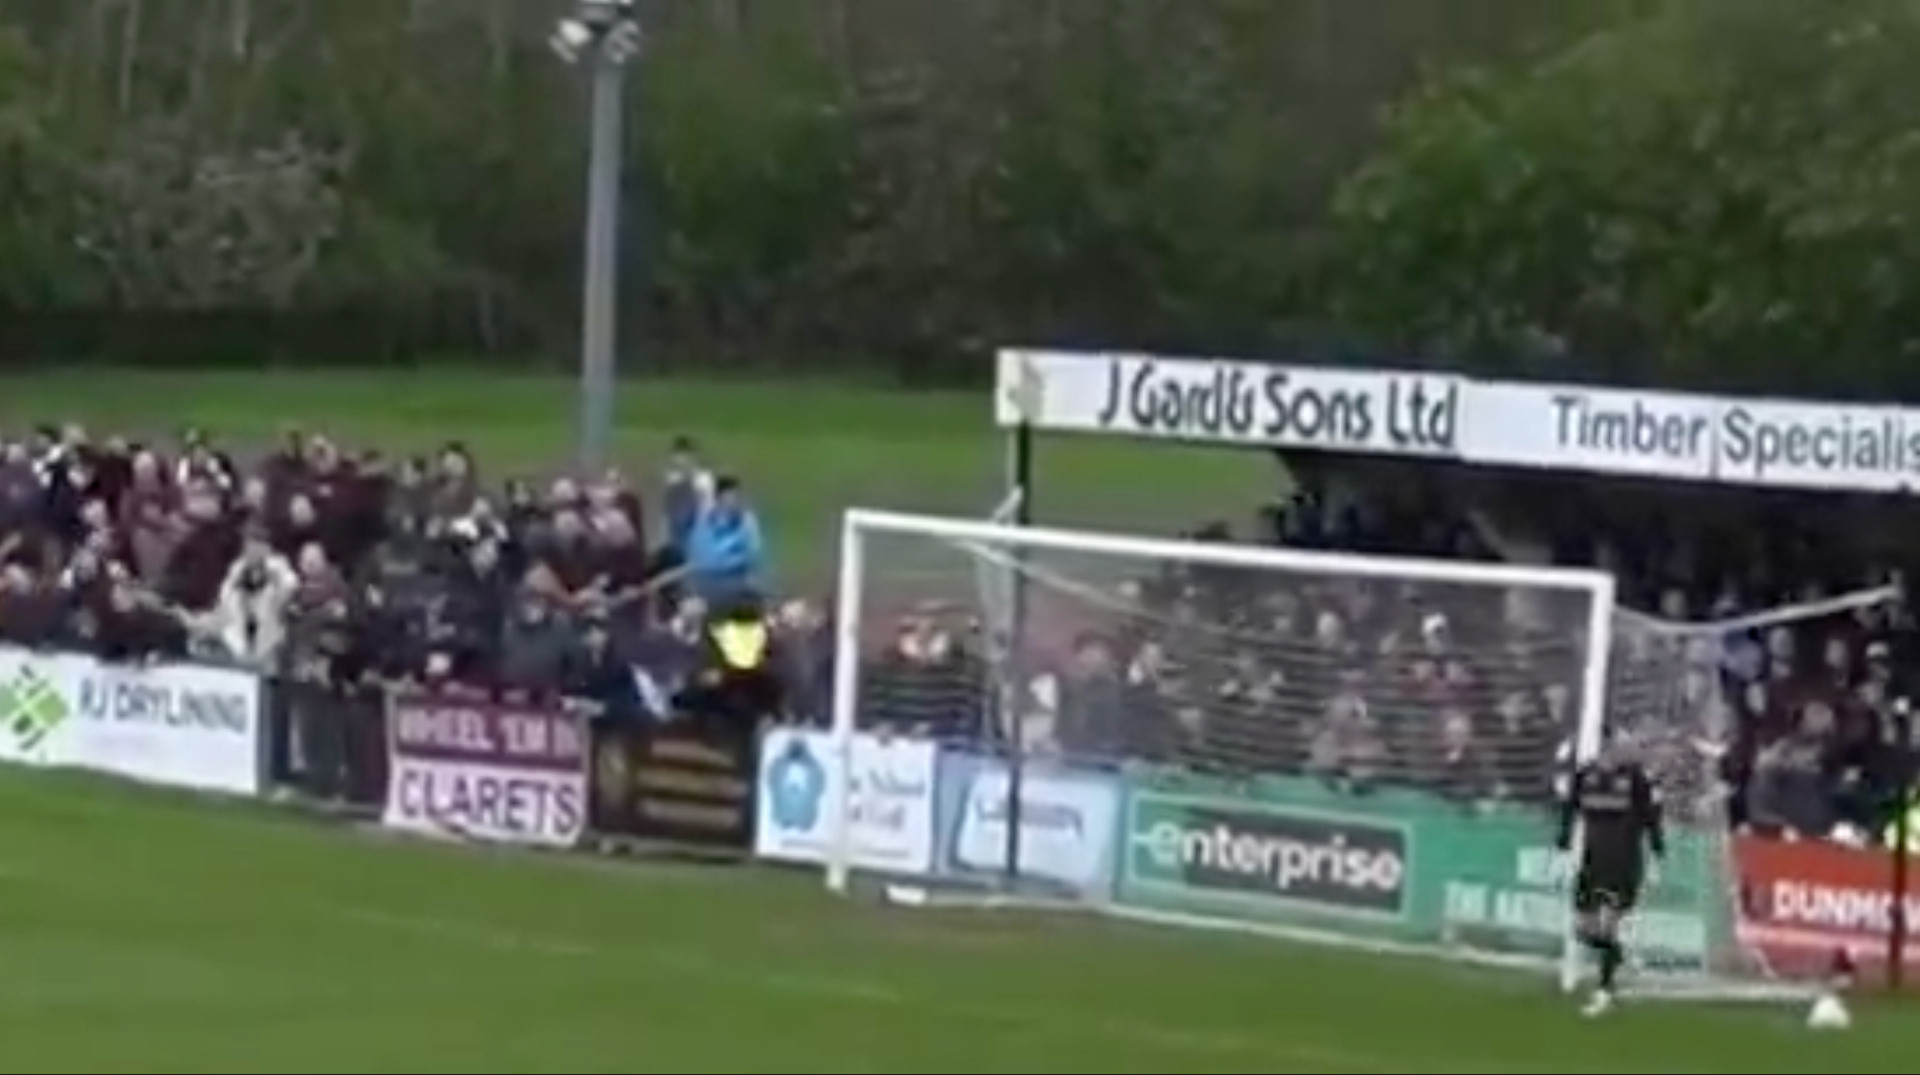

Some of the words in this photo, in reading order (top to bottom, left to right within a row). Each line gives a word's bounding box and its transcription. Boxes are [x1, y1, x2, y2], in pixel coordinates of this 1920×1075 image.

[1100, 358, 1120, 427] J
[1263, 372, 1373, 443] Sons
[1387, 378, 1458, 450] Ltd
[1553, 394, 1708, 459] Timber
[401, 767, 578, 836] CLARETS
[1148, 820, 1403, 892] enterprise
